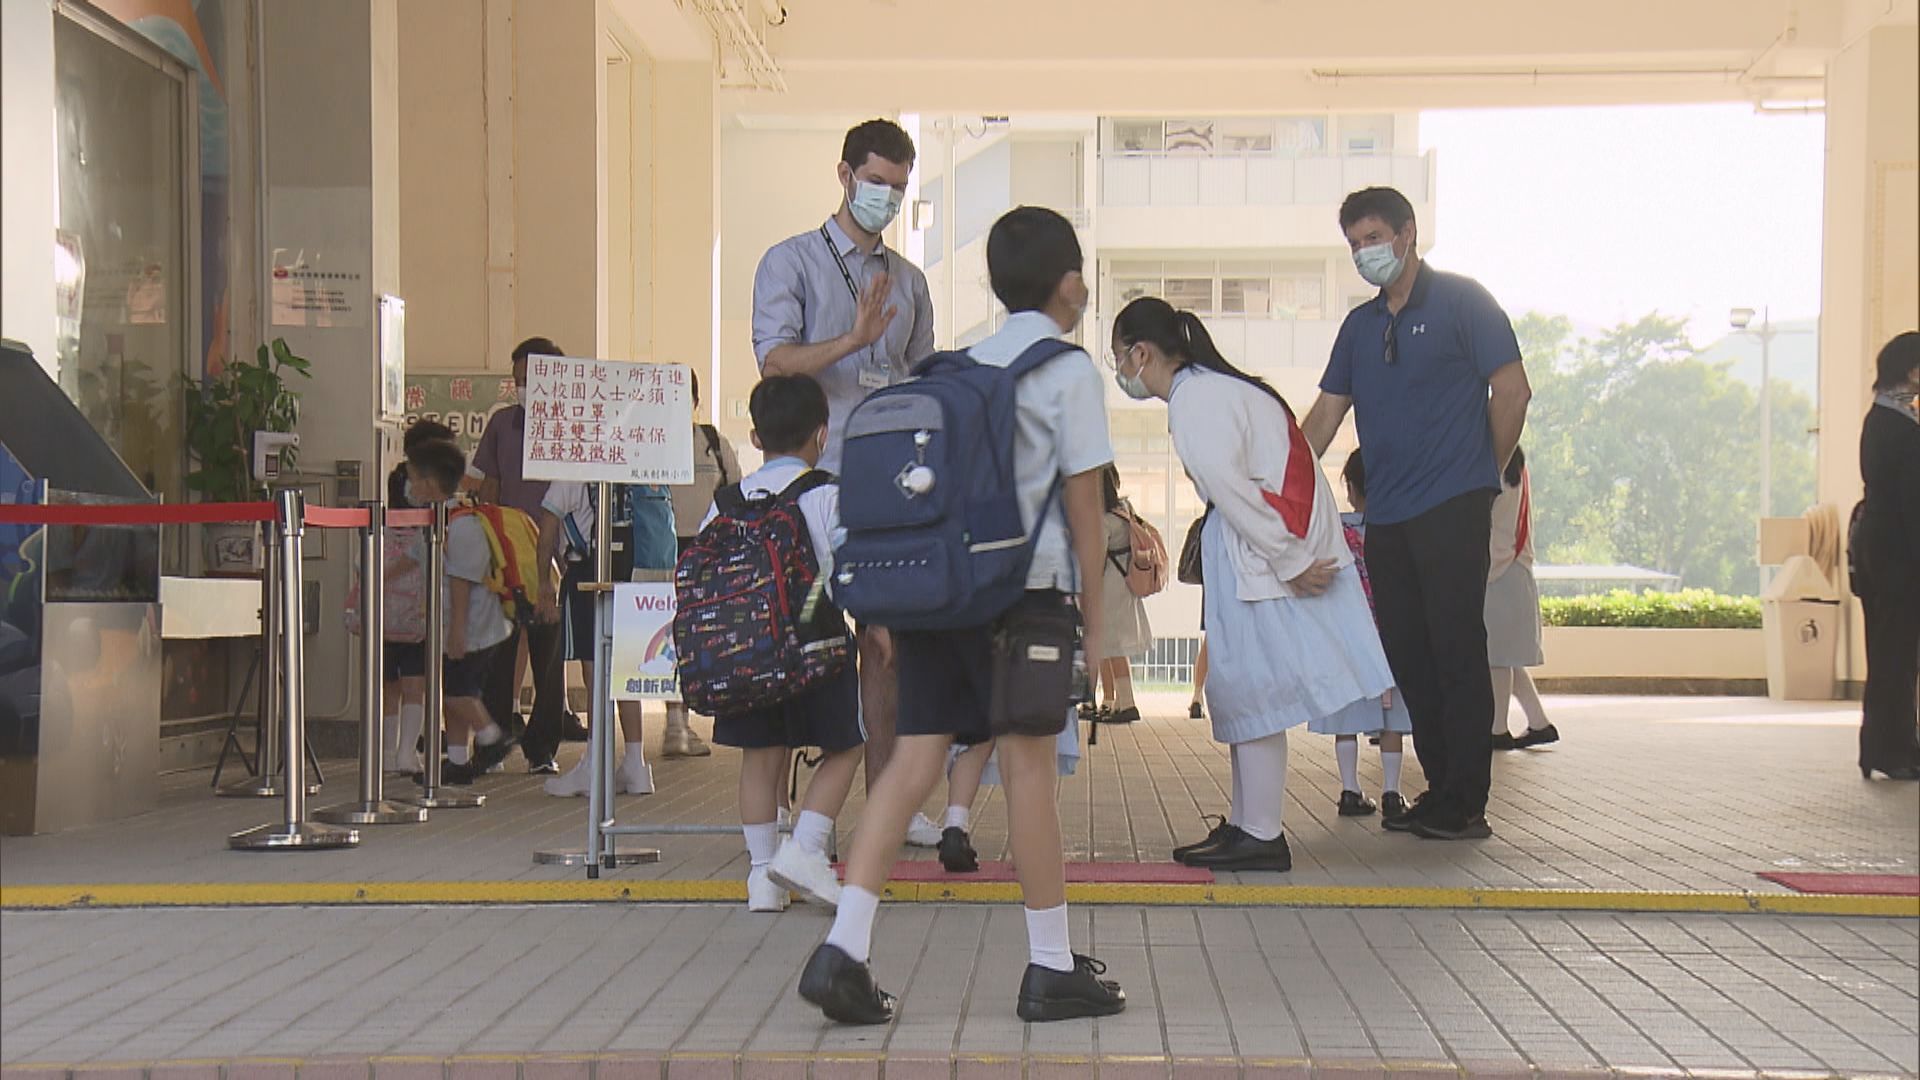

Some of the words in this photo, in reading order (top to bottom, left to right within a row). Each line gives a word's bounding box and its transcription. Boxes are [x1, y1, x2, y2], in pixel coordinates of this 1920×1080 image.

[531, 421, 666, 445] 消毒雙手及確保
[626, 678, 679, 693] 創新與
